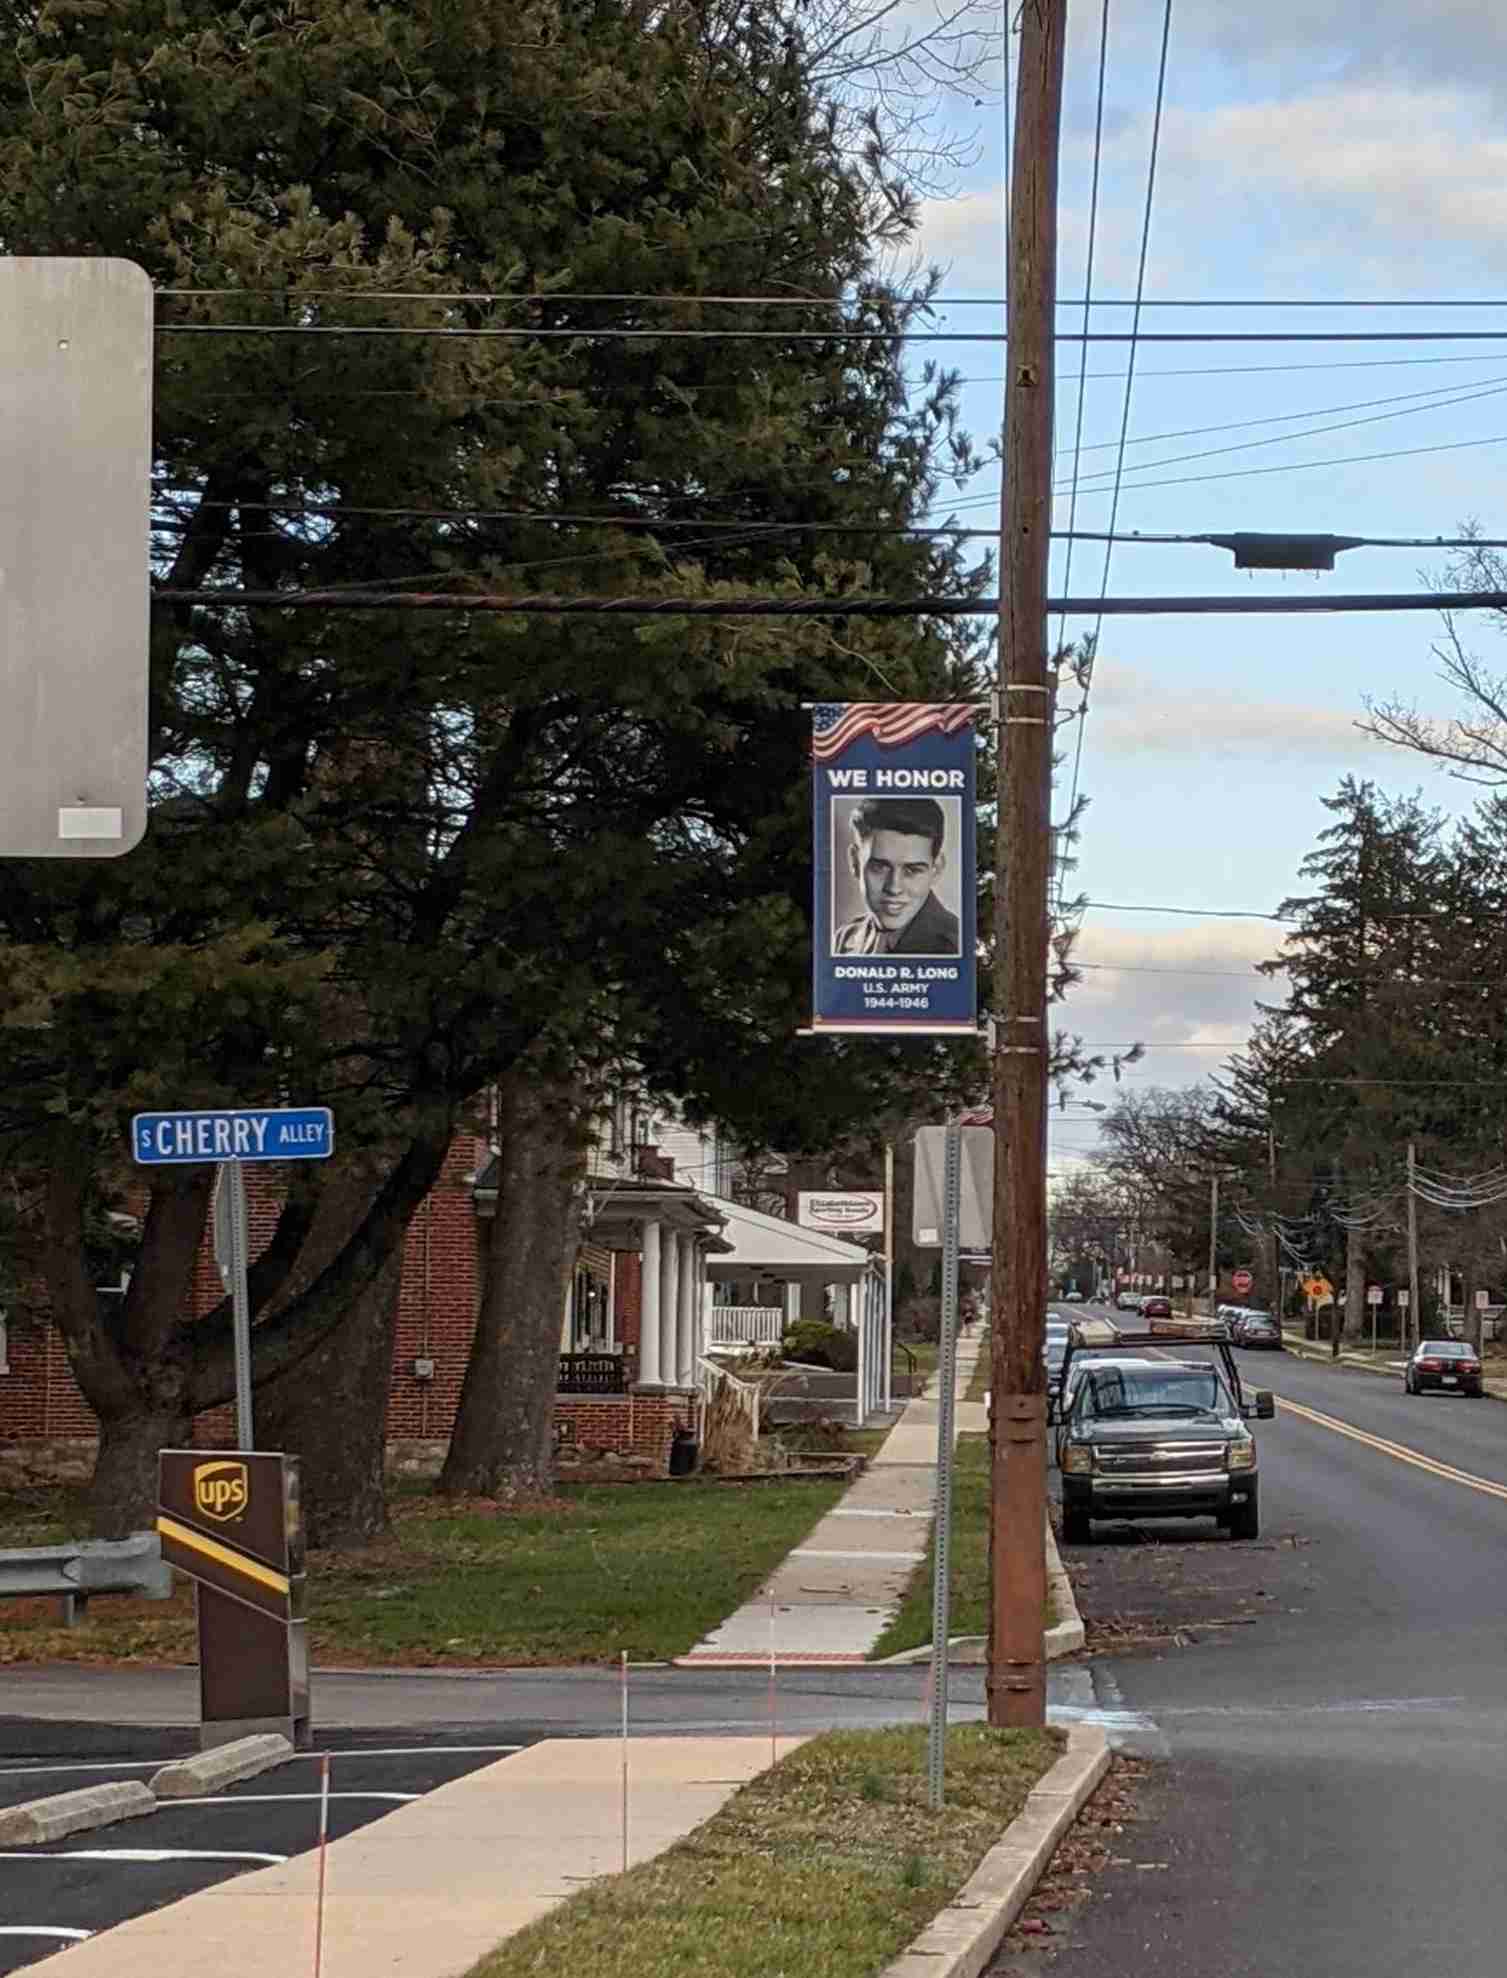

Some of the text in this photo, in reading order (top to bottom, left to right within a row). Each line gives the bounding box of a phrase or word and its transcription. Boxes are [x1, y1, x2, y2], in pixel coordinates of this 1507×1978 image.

[827, 769, 965, 788] WE HONOR
[834, 966, 958, 979] DONALD R. LONG
[863, 982, 929, 994] U.S. ARMY
[864, 996, 929, 1009] 1944-1946
[141, 1117, 325, 1155] S CHERRY ALLEY
[199, 1478, 244, 1512] ups
